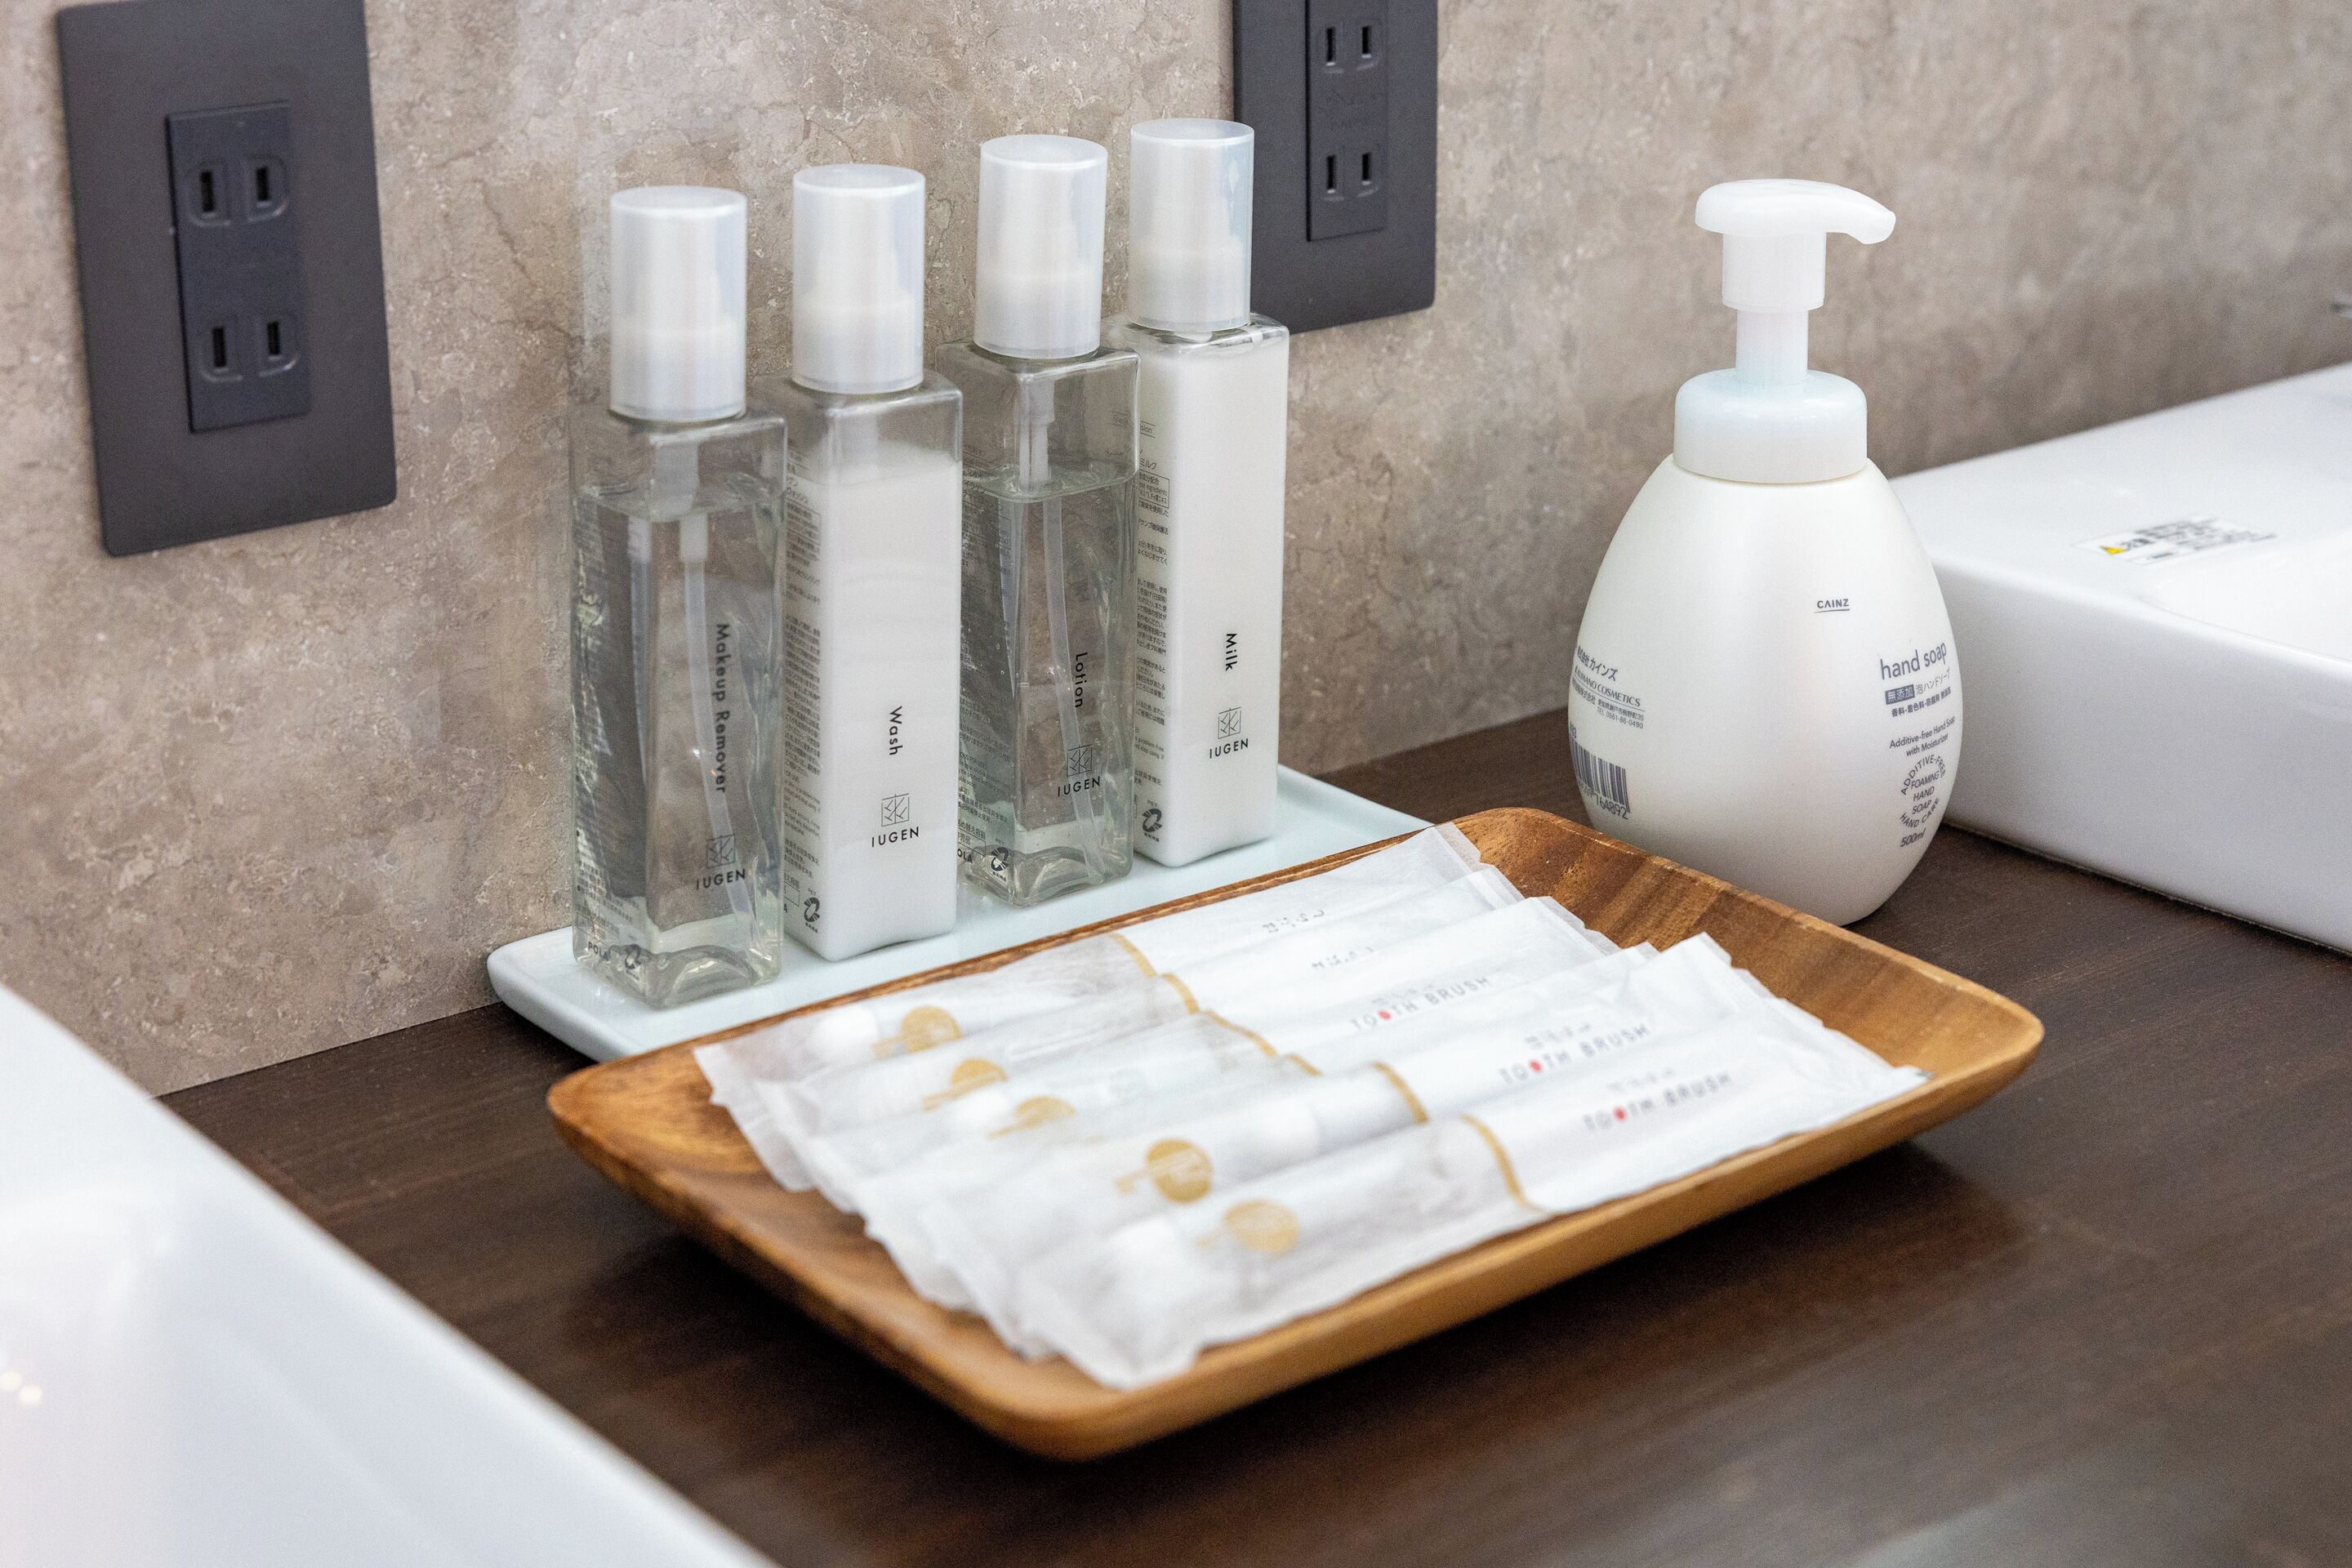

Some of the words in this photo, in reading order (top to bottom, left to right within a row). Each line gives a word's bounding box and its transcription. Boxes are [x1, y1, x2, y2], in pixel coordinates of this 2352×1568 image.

[1816, 599, 1850, 608] CAINZ
[712, 623, 732, 702] Makeup
[1226, 633, 1236, 671] Milk
[1881, 649, 1920, 679] hand
[1923, 642, 1947, 667] soap
[1075, 652, 1088, 708] Lotion
[1597, 684, 1641, 706] COSMETICS
[889, 706, 902, 756] Wash
[1889, 731, 1933, 749] Additive-free
[1933, 722, 1946, 735] Hand
[715, 711, 731, 793] Remover
[1209, 738, 1249, 758] IUGEN
[1906, 746, 1920, 756] with
[1921, 733, 1949, 752] Moisturizer
[1058, 775, 1101, 796] IUGEN
[1911, 771, 1940, 790] FOAMING
[1913, 786, 1935, 801] HAND
[1900, 812, 1919, 828] HAND
[1922, 797, 1940, 823] CARE
[1912, 800, 1932, 814] SOAP
[871, 826, 920, 847] IUGEN
[1900, 827, 1926, 848] 500ml
[957, 848, 973, 863] OLA
[696, 869, 746, 889] IUGEN
[588, 941, 608, 960] POLA
[1426, 975, 1490, 1007] BRUSH
[1579, 1023, 1651, 1059] BRUSH
